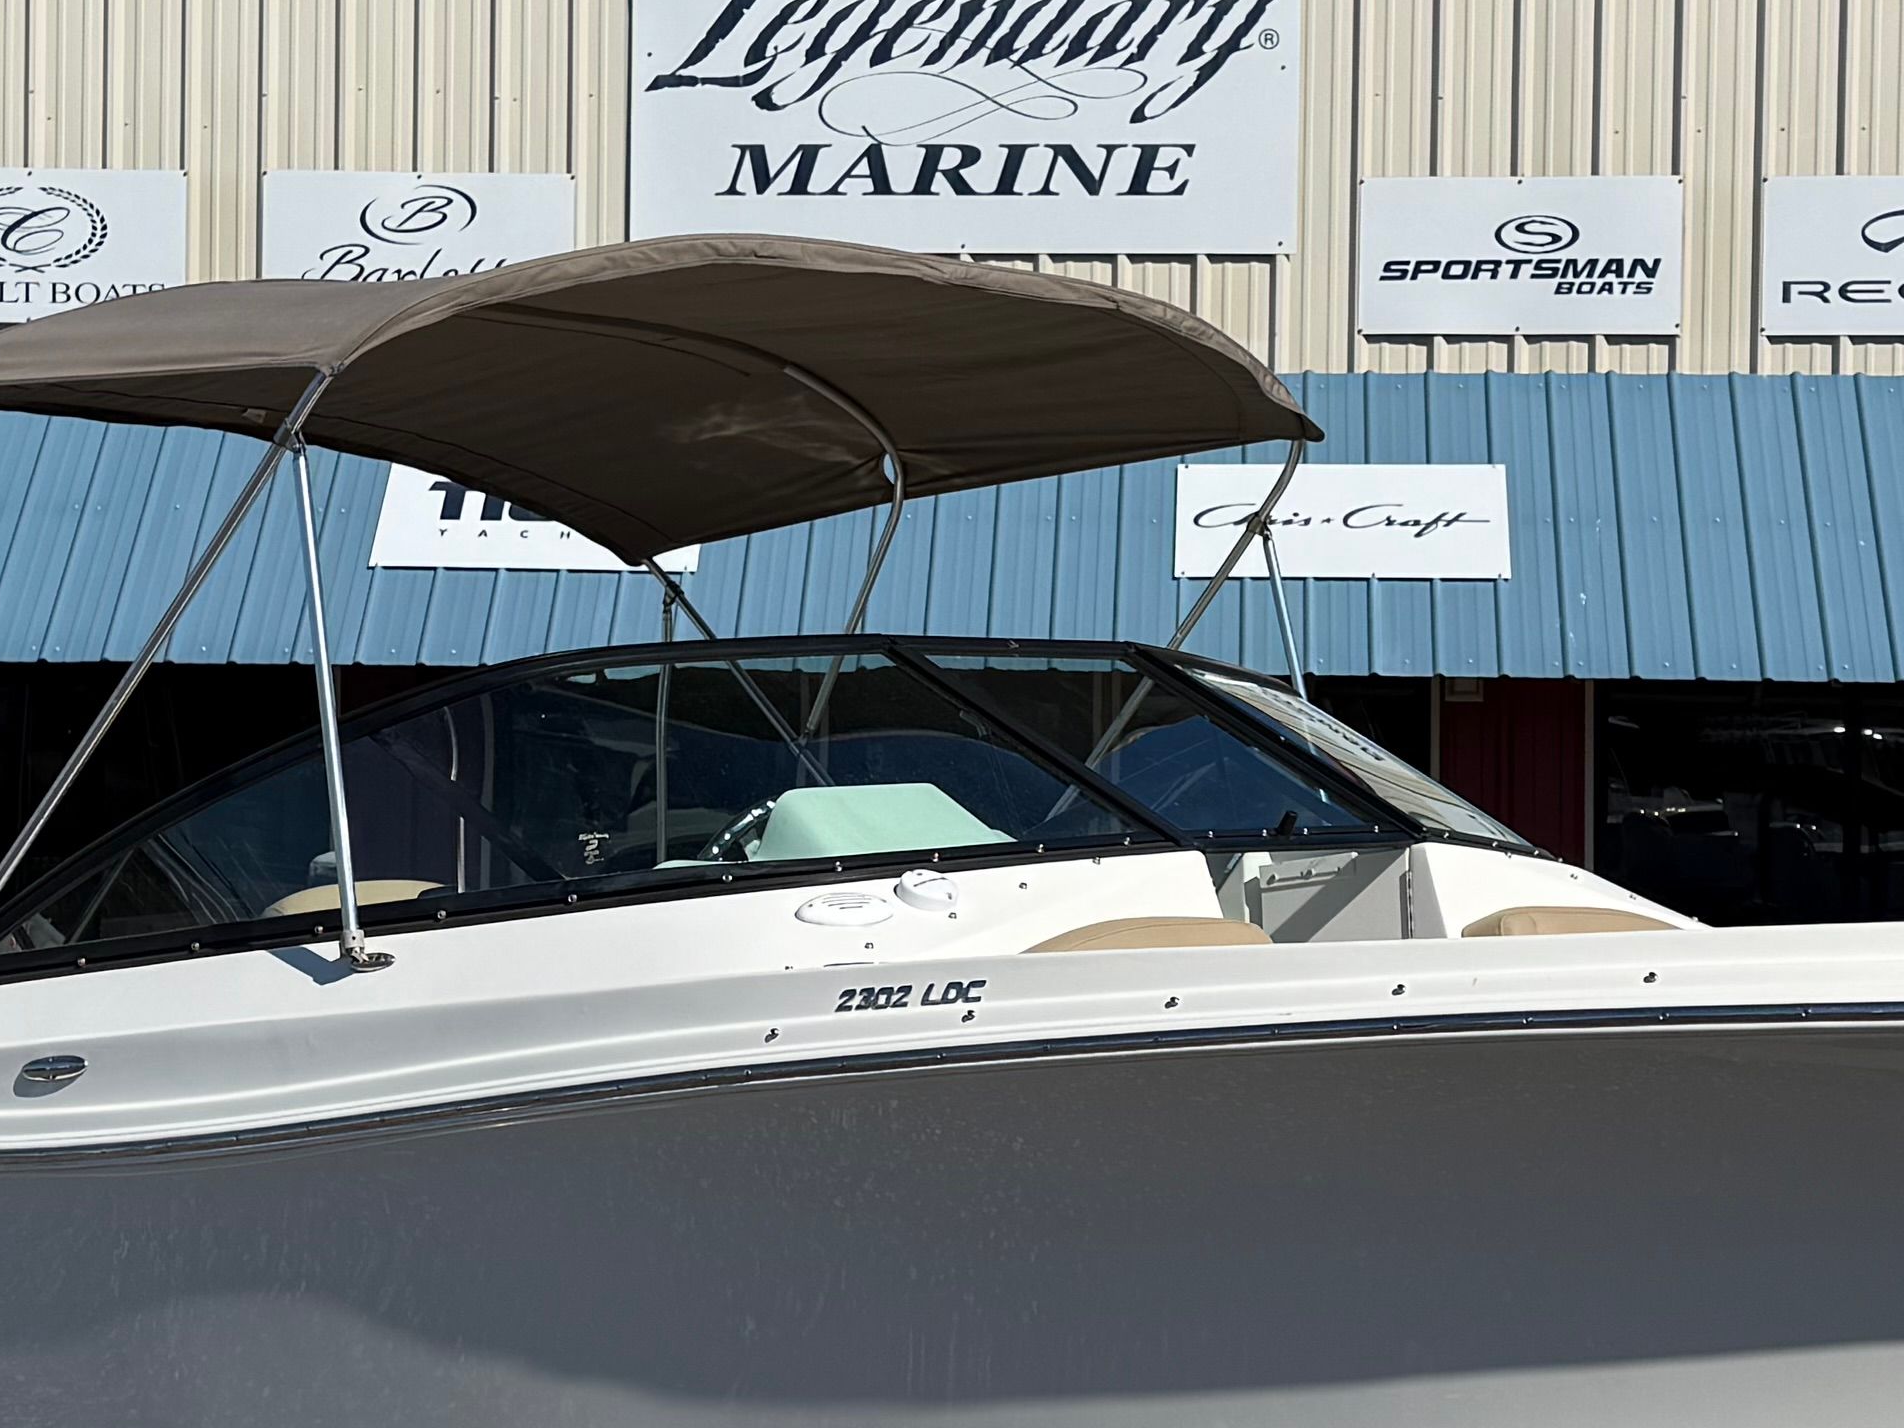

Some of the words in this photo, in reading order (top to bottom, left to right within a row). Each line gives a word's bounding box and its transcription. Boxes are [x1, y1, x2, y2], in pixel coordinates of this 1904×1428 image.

[714, 143, 1196, 196] MARINE
[1379, 258, 1662, 281] SPORTSMAN
[1554, 281, 1653, 295] BOATS
[1342, 503, 1491, 538] Craft
[834, 984, 913, 1012] 2302
